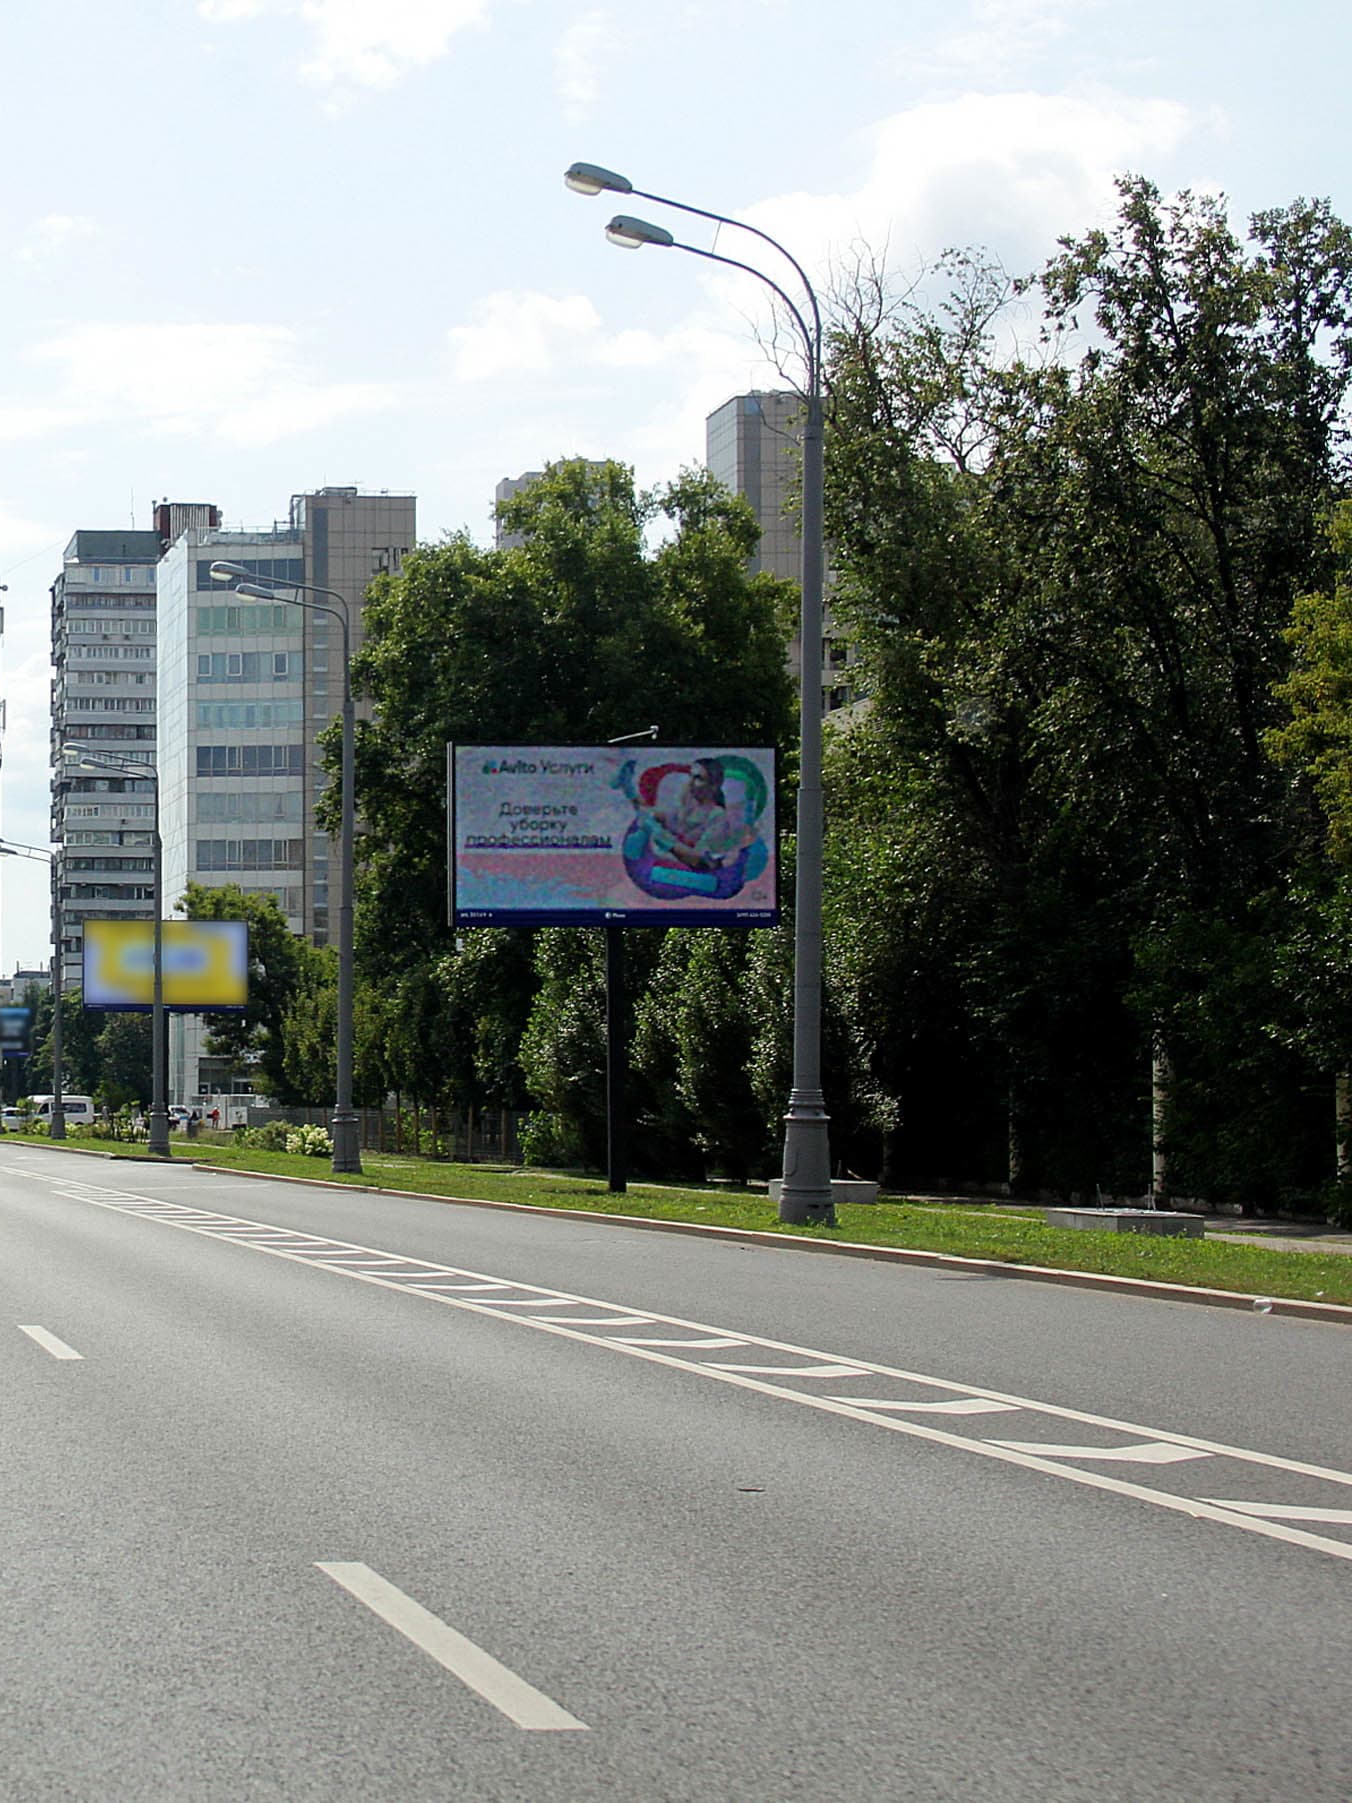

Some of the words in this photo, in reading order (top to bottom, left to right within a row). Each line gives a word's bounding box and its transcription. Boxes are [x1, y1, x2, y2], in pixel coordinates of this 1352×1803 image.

[499, 759, 537, 774] Avito
[540, 760, 594, 776] Услуги
[498, 801, 578, 817] Доверьте
[509, 818, 567, 834] уборку
